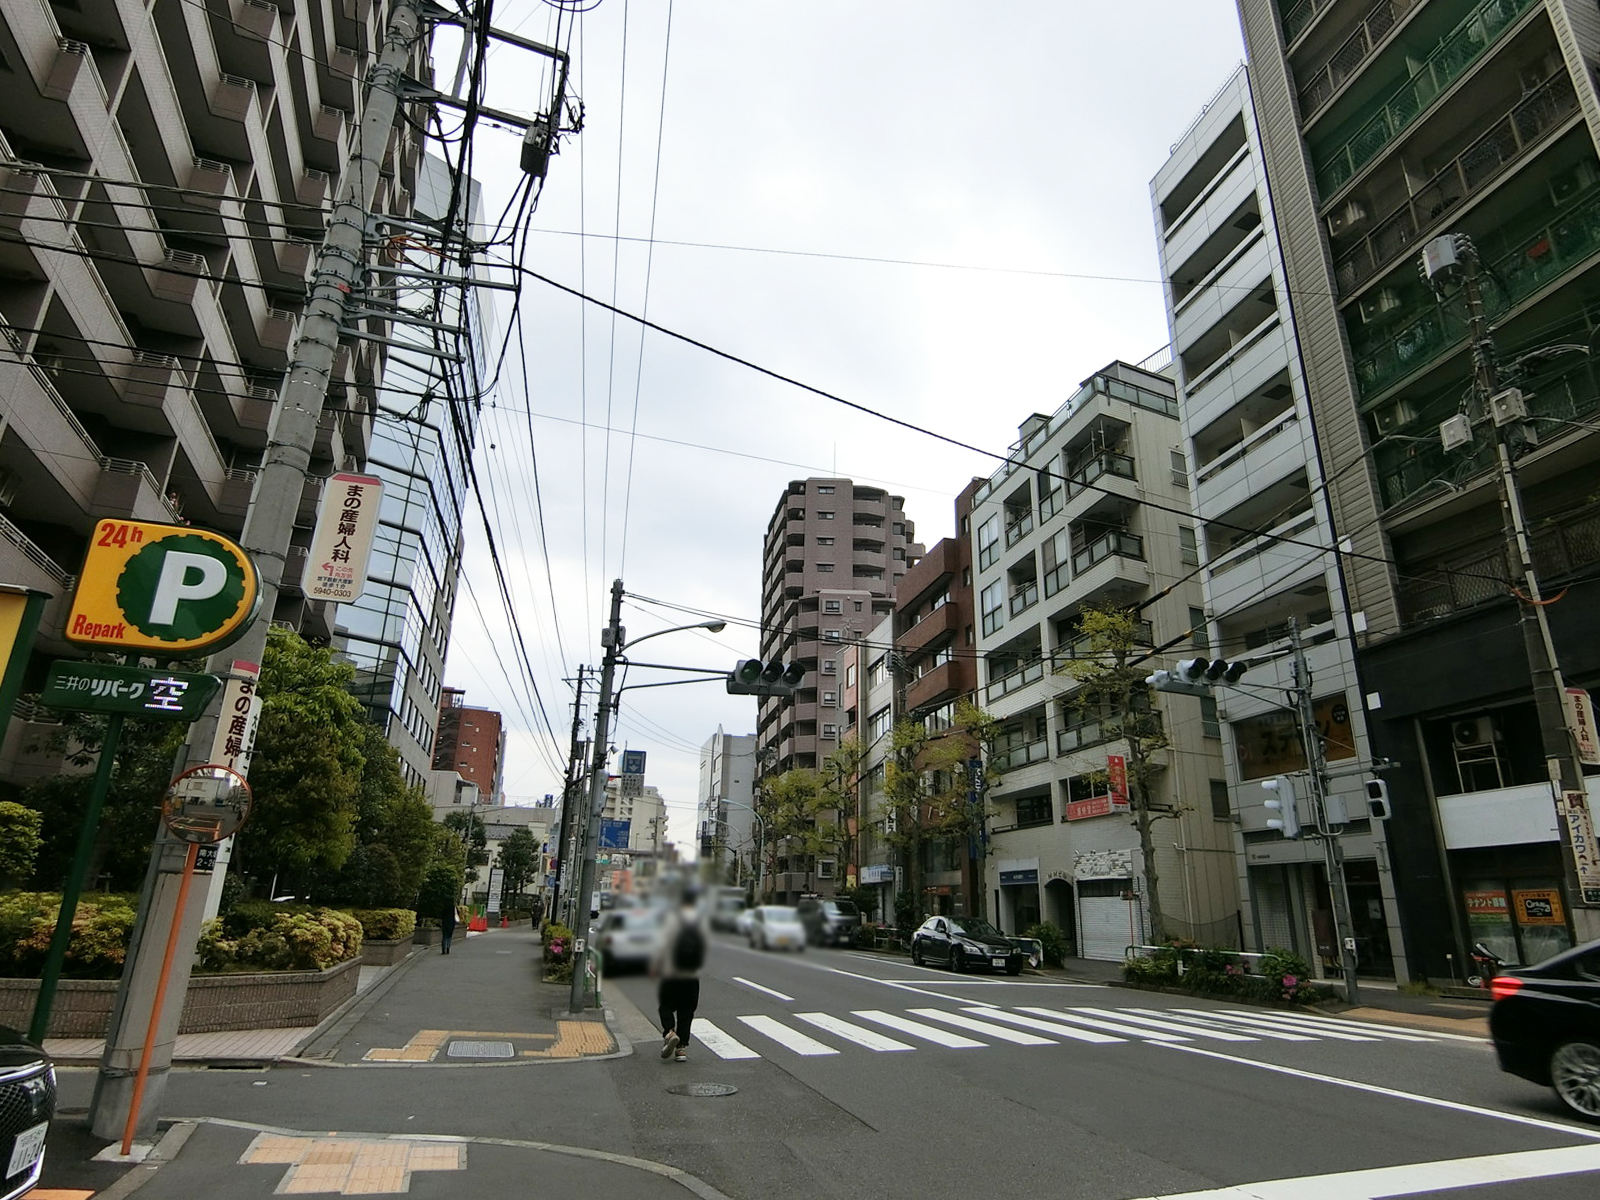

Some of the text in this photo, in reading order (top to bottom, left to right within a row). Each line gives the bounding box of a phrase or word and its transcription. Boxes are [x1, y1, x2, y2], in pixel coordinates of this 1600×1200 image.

[98, 523, 143, 549] 24h
[331, 485, 364, 563] まの産婦人科
[148, 550, 228, 626] P
[313, 587, 352, 597] 5940-0303
[72, 614, 126, 639] Repark
[54, 675, 145, 699] 三井のリパーク
[145, 676, 189, 710] 空
[223, 676, 256, 768] まの産婦
